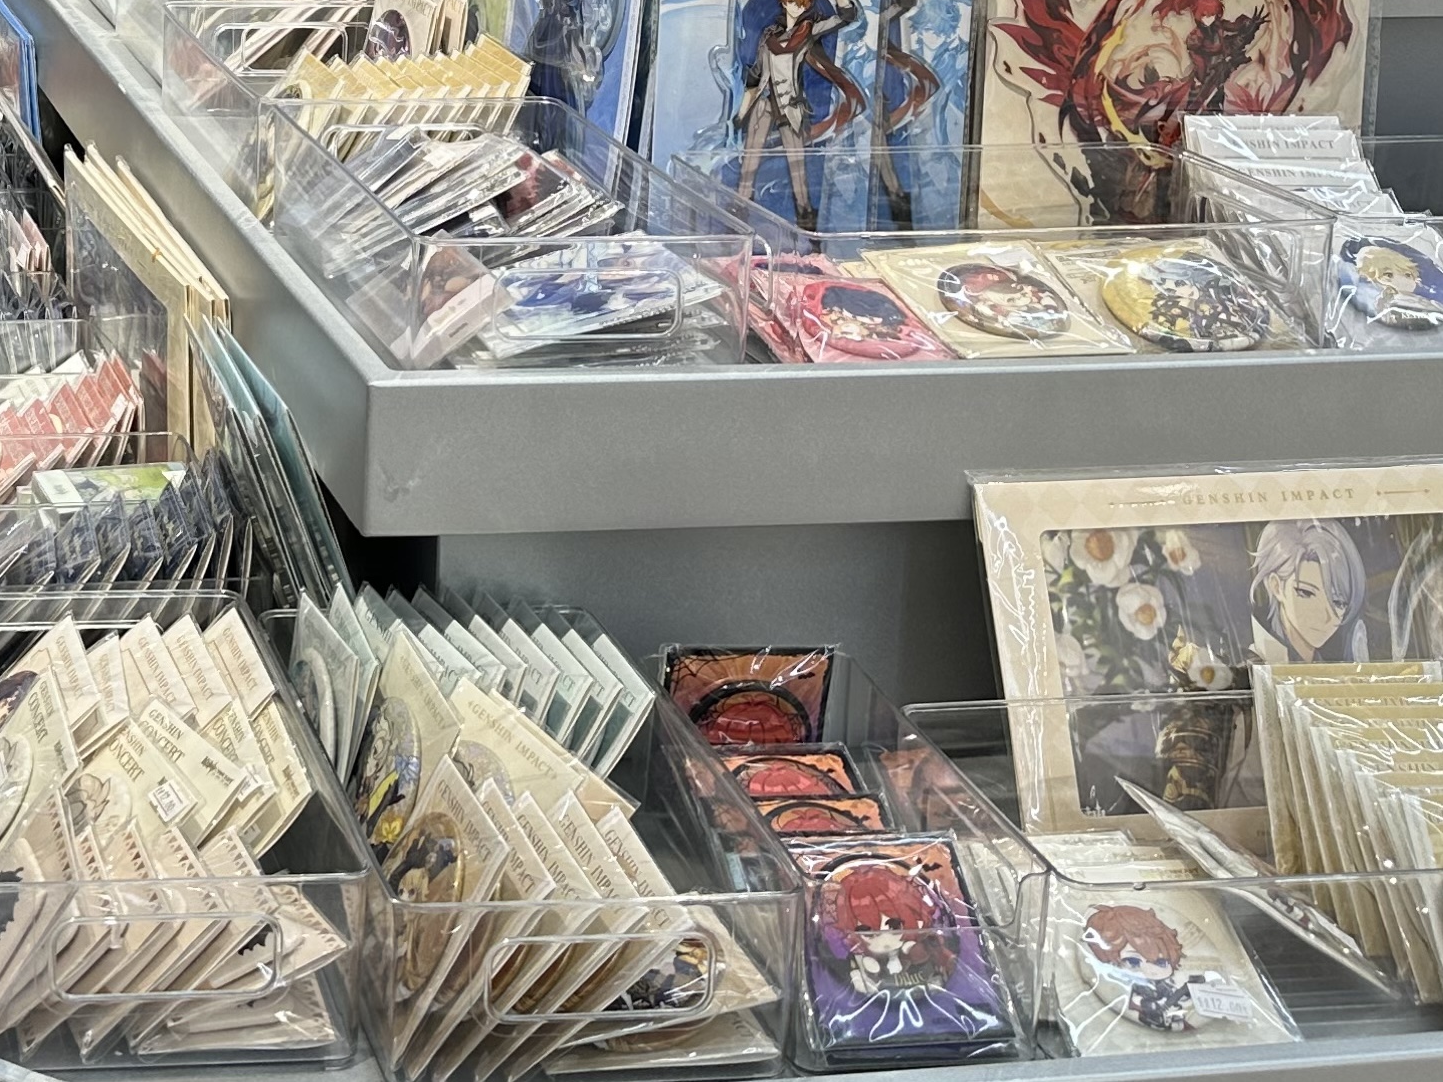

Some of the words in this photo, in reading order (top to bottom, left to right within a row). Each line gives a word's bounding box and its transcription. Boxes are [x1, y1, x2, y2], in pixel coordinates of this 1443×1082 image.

[1283, 138, 1336, 151] IMPACT
[1182, 491, 1269, 507] GENSHIN
[1280, 487, 1356, 503] IMPACT
[138, 719, 186, 764] CONCERT
[148, 708, 185, 741] GENSHIN
[471, 702, 513, 745] GENSHIN
[515, 740, 555, 777] IMPACT
[437, 779, 463, 825] GENSHIN
[463, 819, 492, 864] IMPACT
[517, 813, 550, 864] GENSHIN
[558, 814, 595, 866] GENSHIN
[605, 829, 642, 879] GENSHIN
